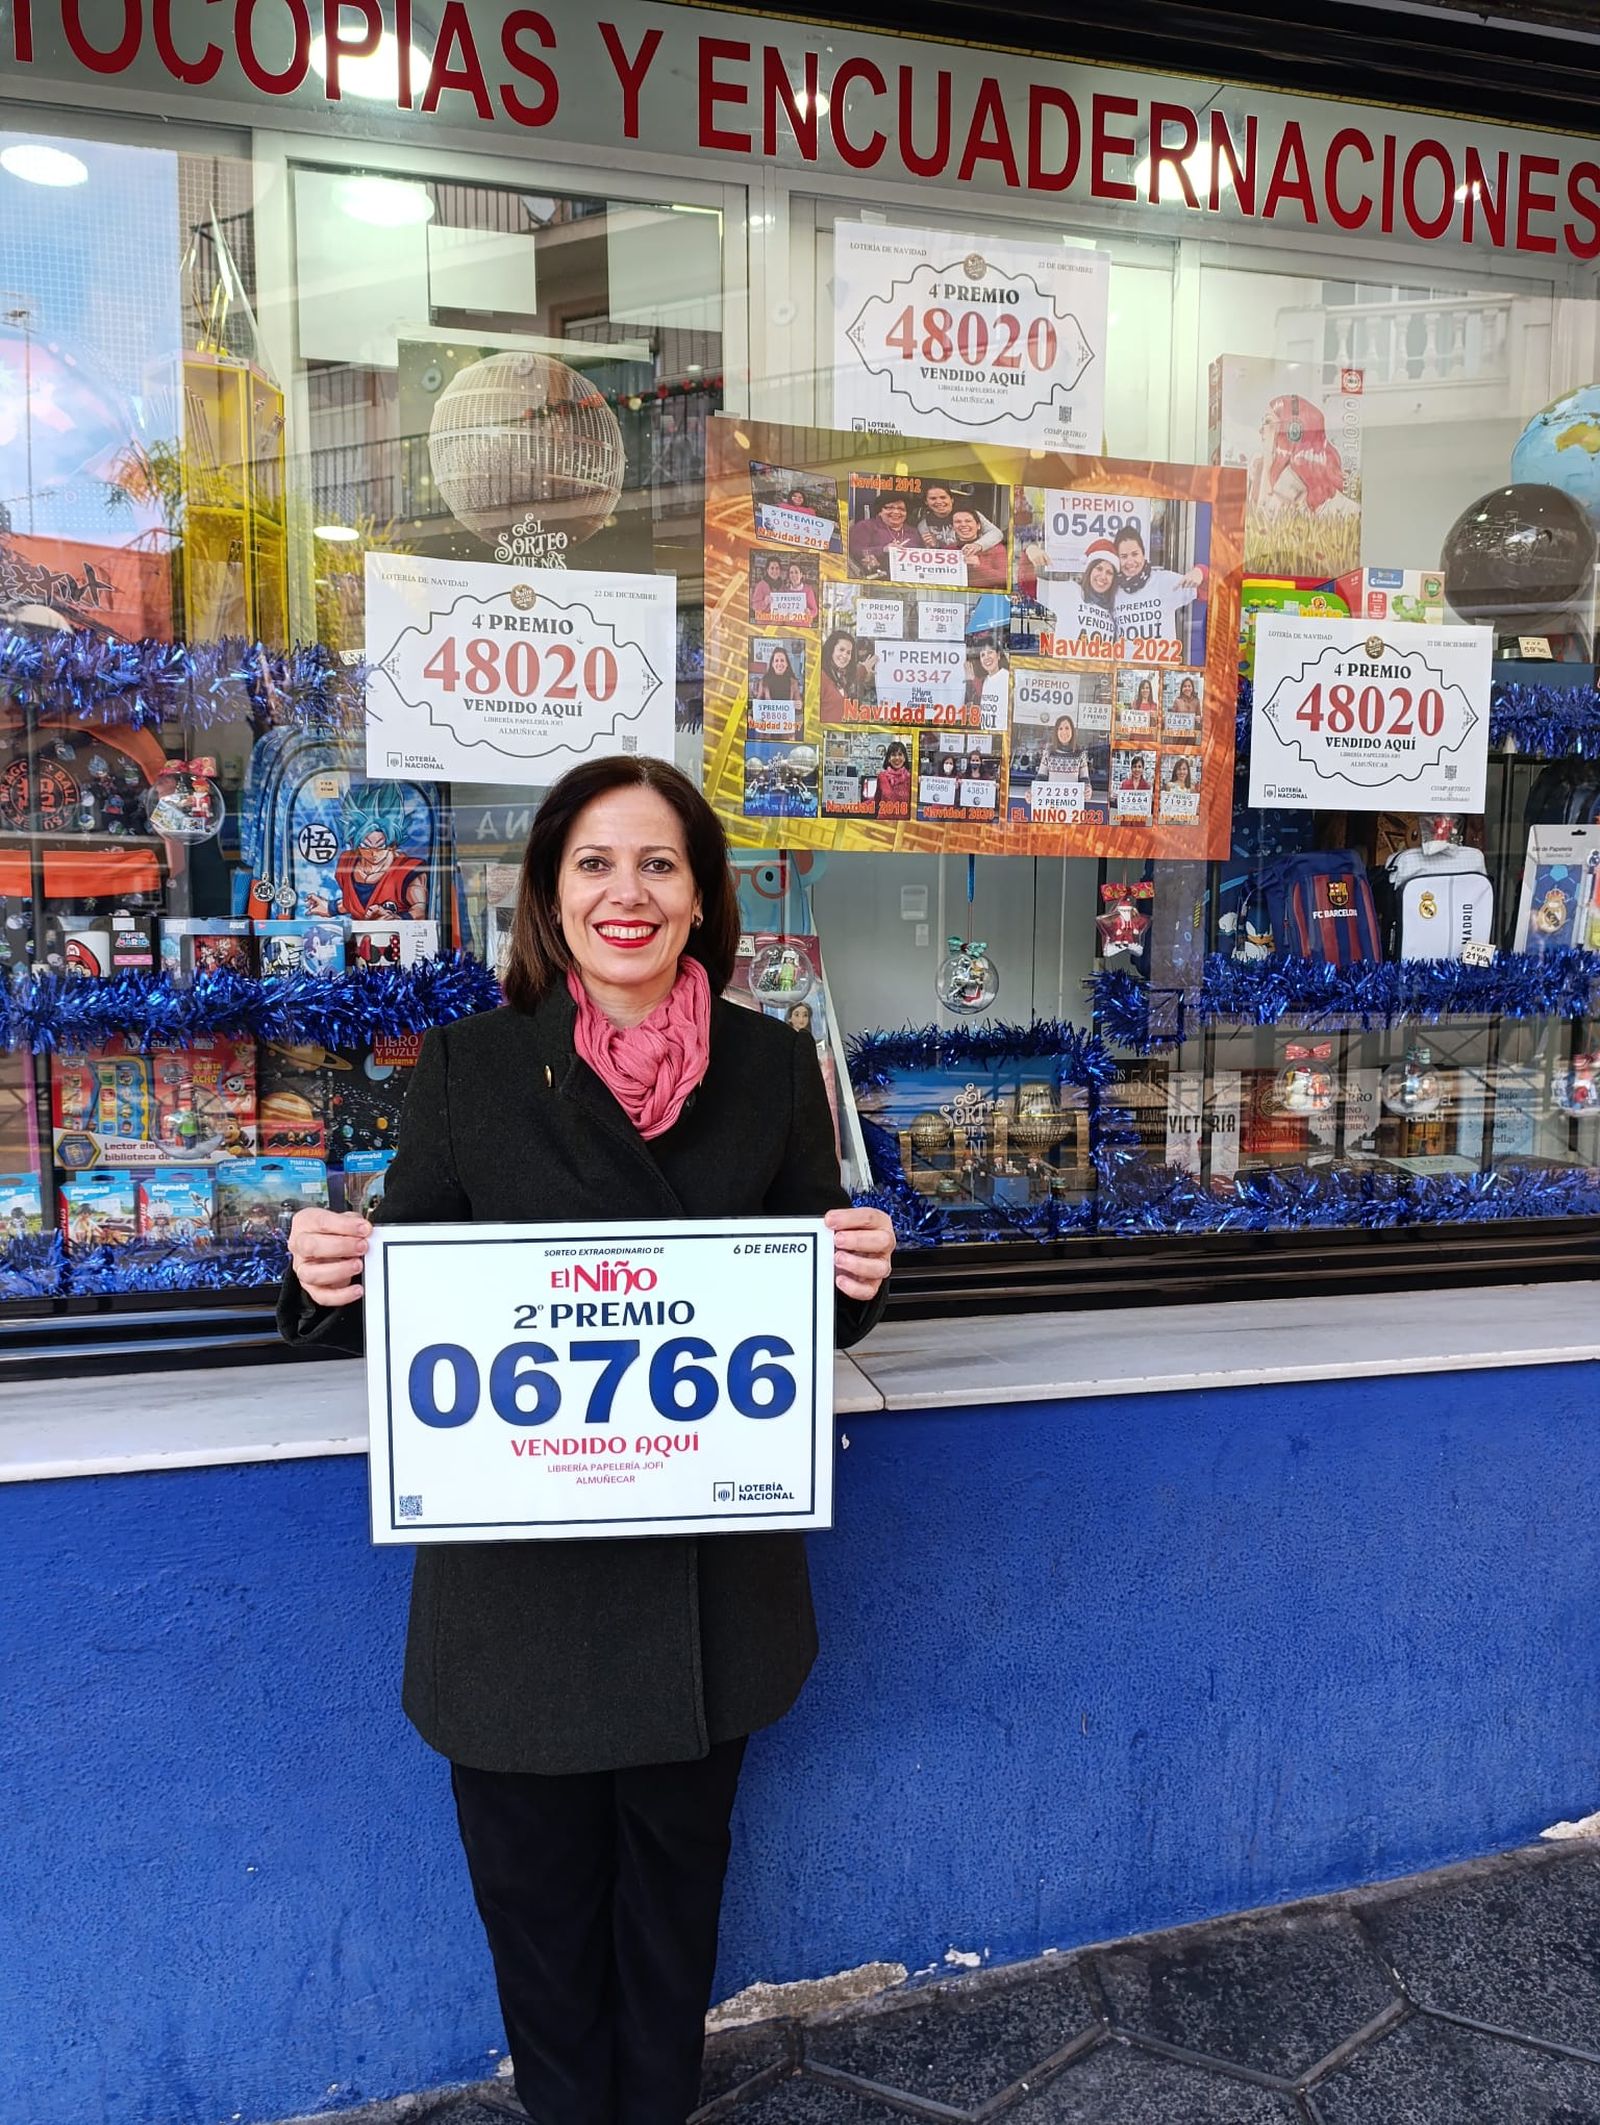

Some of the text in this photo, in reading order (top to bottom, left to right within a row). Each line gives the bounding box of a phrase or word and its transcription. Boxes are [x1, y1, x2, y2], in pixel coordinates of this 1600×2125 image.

[597, 22, 664, 138] Y
[697, 37, 1600, 259] ENCUADERNACIONES
[850, 241, 927, 257] LOTERÍA DE NAVIDAD
[1046, 262, 1056, 270] DE
[1057, 263, 1094, 274] DICIEMBRE
[944, 284, 1020, 305] PREMIO
[885, 305, 1057, 372] 48020
[920, 367, 1026, 386] VENDIDO AQUÍ
[867, 420, 896, 429] LOTERÍA
[868, 428, 903, 436] NACIONAL
[851, 473, 922, 493] Navidad 2012
[1072, 498, 1134, 513] PREMIO
[512, 513, 544, 536] EL
[781, 511, 824, 528] PREMIO
[758, 527, 829, 549] Navidad 2015
[494, 531, 568, 563] SORTEO
[897, 548, 959, 565] 76058
[914, 564, 958, 575] Premio
[381, 573, 469, 588] LOTERÍA DE NAVIDAD
[594, 589, 658, 601] 22 DE DICIEMBRE
[869, 603, 900, 612] PREMIO
[933, 607, 958, 615] PREMIO
[866, 612, 895, 621] 03347
[489, 614, 574, 635] PREMIO
[1268, 630, 1293, 639] LOTERÍA
[1303, 633, 1333, 641] NAVIDAD
[1039, 632, 1183, 662] Navidad 2022
[899, 651, 960, 665] PREMIO
[423, 636, 618, 702] 48020
[1347, 663, 1412, 679] PREMIO
[893, 668, 952, 684] 03347
[1031, 678, 1070, 690] PREMIO
[1019, 687, 1074, 706] 05490
[463, 698, 583, 718] VENDIDO AQUÍ
[842, 698, 982, 727] Navidad 2018
[1296, 683, 1444, 737] 48020
[483, 716, 514, 724] LIBRERÍA
[515, 717, 549, 726] PAPELERÍA
[761, 711, 788, 720] 58808
[748, 720, 781, 730] Navidad
[498, 726, 548, 737] ALMUÑECAR
[1325, 736, 1416, 752] VENDIDO AQUÍ
[404, 754, 437, 763] LOTERÍA
[1350, 760, 1388, 768] ALMUÑECAR
[405, 761, 445, 771] NACIONAL
[1037, 787, 1079, 798] 72289
[1278, 786, 1302, 794] LOTERÍA
[825, 800, 908, 816] Navidad 2018
[1045, 798, 1077, 807] PREMIO
[923, 806, 967, 818] Navidad
[1011, 807, 1028, 821] EL
[1032, 807, 1067, 823] NIÑO
[1072, 809, 1104, 824] 2023
[302, 826, 338, 862] 悟
[1313, 909, 1324, 920] FC
[120, 932, 147, 940] SUPER
[115, 938, 150, 949] MARIO
[375, 1035, 419, 1048] LIBRO
[376, 1048, 418, 1057] Y PUZLE
[1169, 1114, 1236, 1134] VICTRIA
[104, 1141, 137, 1151] Lector
[104, 1152, 157, 1162] biblioteca
[346, 1152, 383, 1161] playmobil
[218, 1159, 256, 1169] playmobil
[70, 1186, 110, 1196] playmobil
[152, 1183, 190, 1192] playmobil
[544, 1247, 665, 1257] SORTEO EXTRAORDINARIO DE
[733, 1243, 808, 1255] 6 DE ENERO
[551, 1260, 658, 1296] El Niño
[513, 1300, 695, 1330] 2º PREMIO
[408, 1334, 797, 1429] 06766
[511, 1432, 700, 1457] VENDIDO AQUÍ
[547, 1461, 664, 1473] LIBRERÍA PAPELERÍA JOFI
[576, 1473, 636, 1485] ALMUÑECAR
[738, 1482, 784, 1493] LOTERÍA
[738, 1492, 795, 1501] NACIONAL
